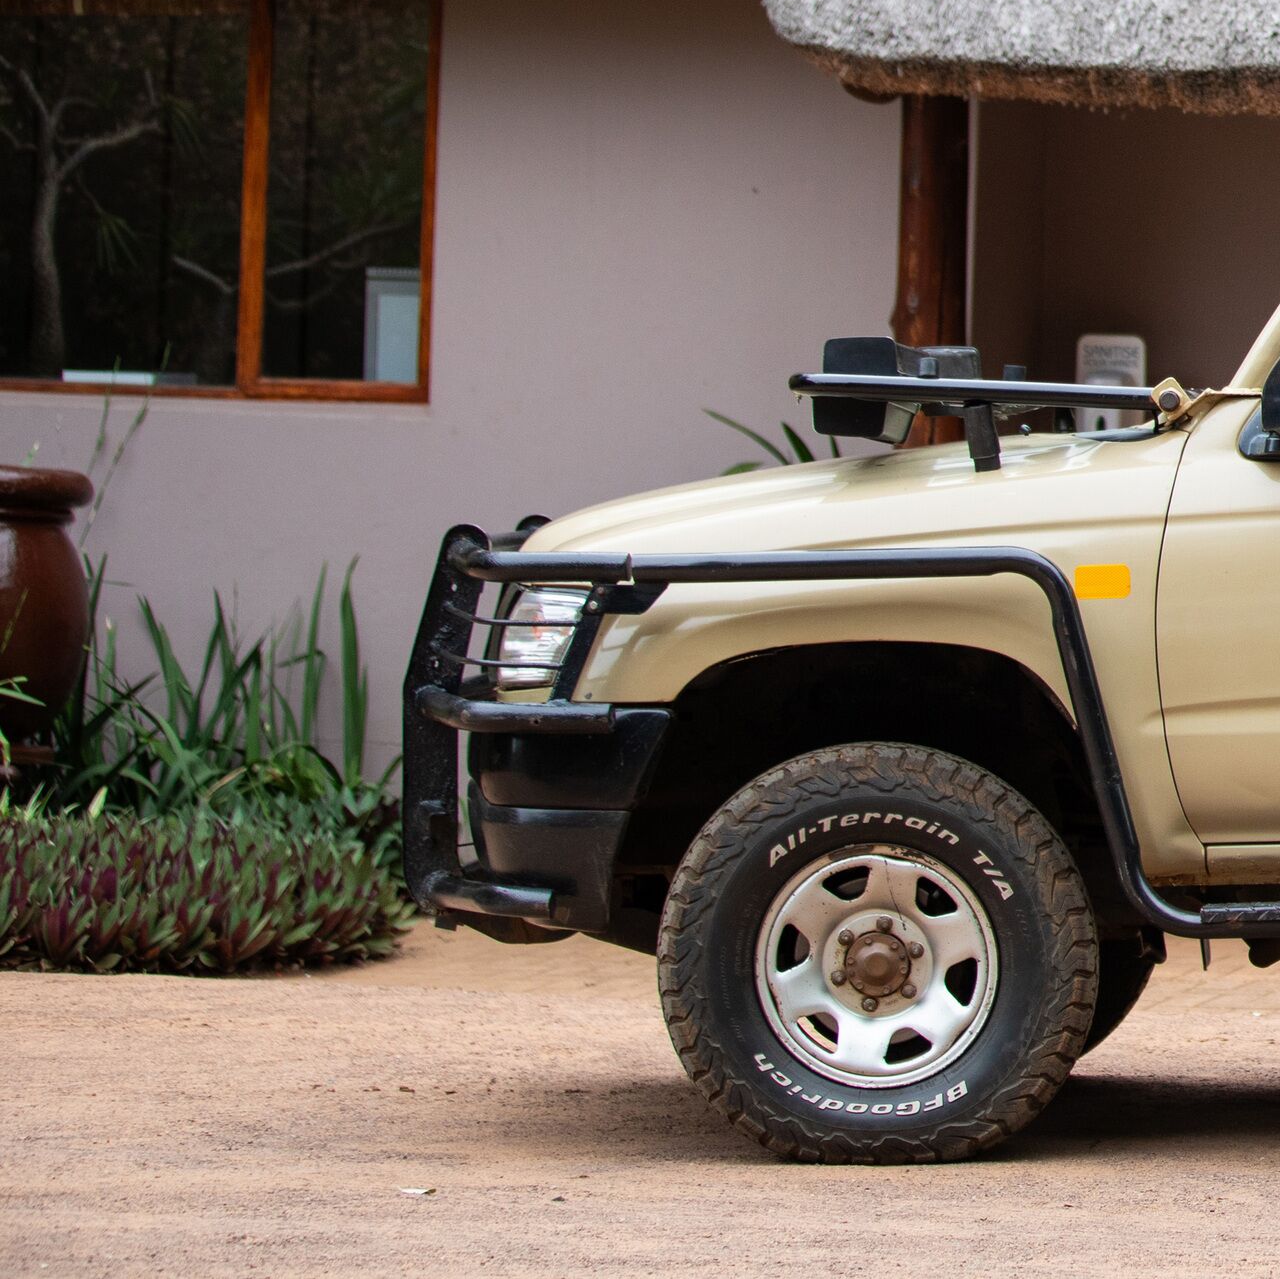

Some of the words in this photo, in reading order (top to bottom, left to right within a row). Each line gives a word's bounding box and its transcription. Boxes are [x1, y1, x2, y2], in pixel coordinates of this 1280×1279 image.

[768, 811, 960, 868] All-Terrain
[972, 849, 1015, 901] T/A
[753, 1053, 969, 1116] BFGoodrich
